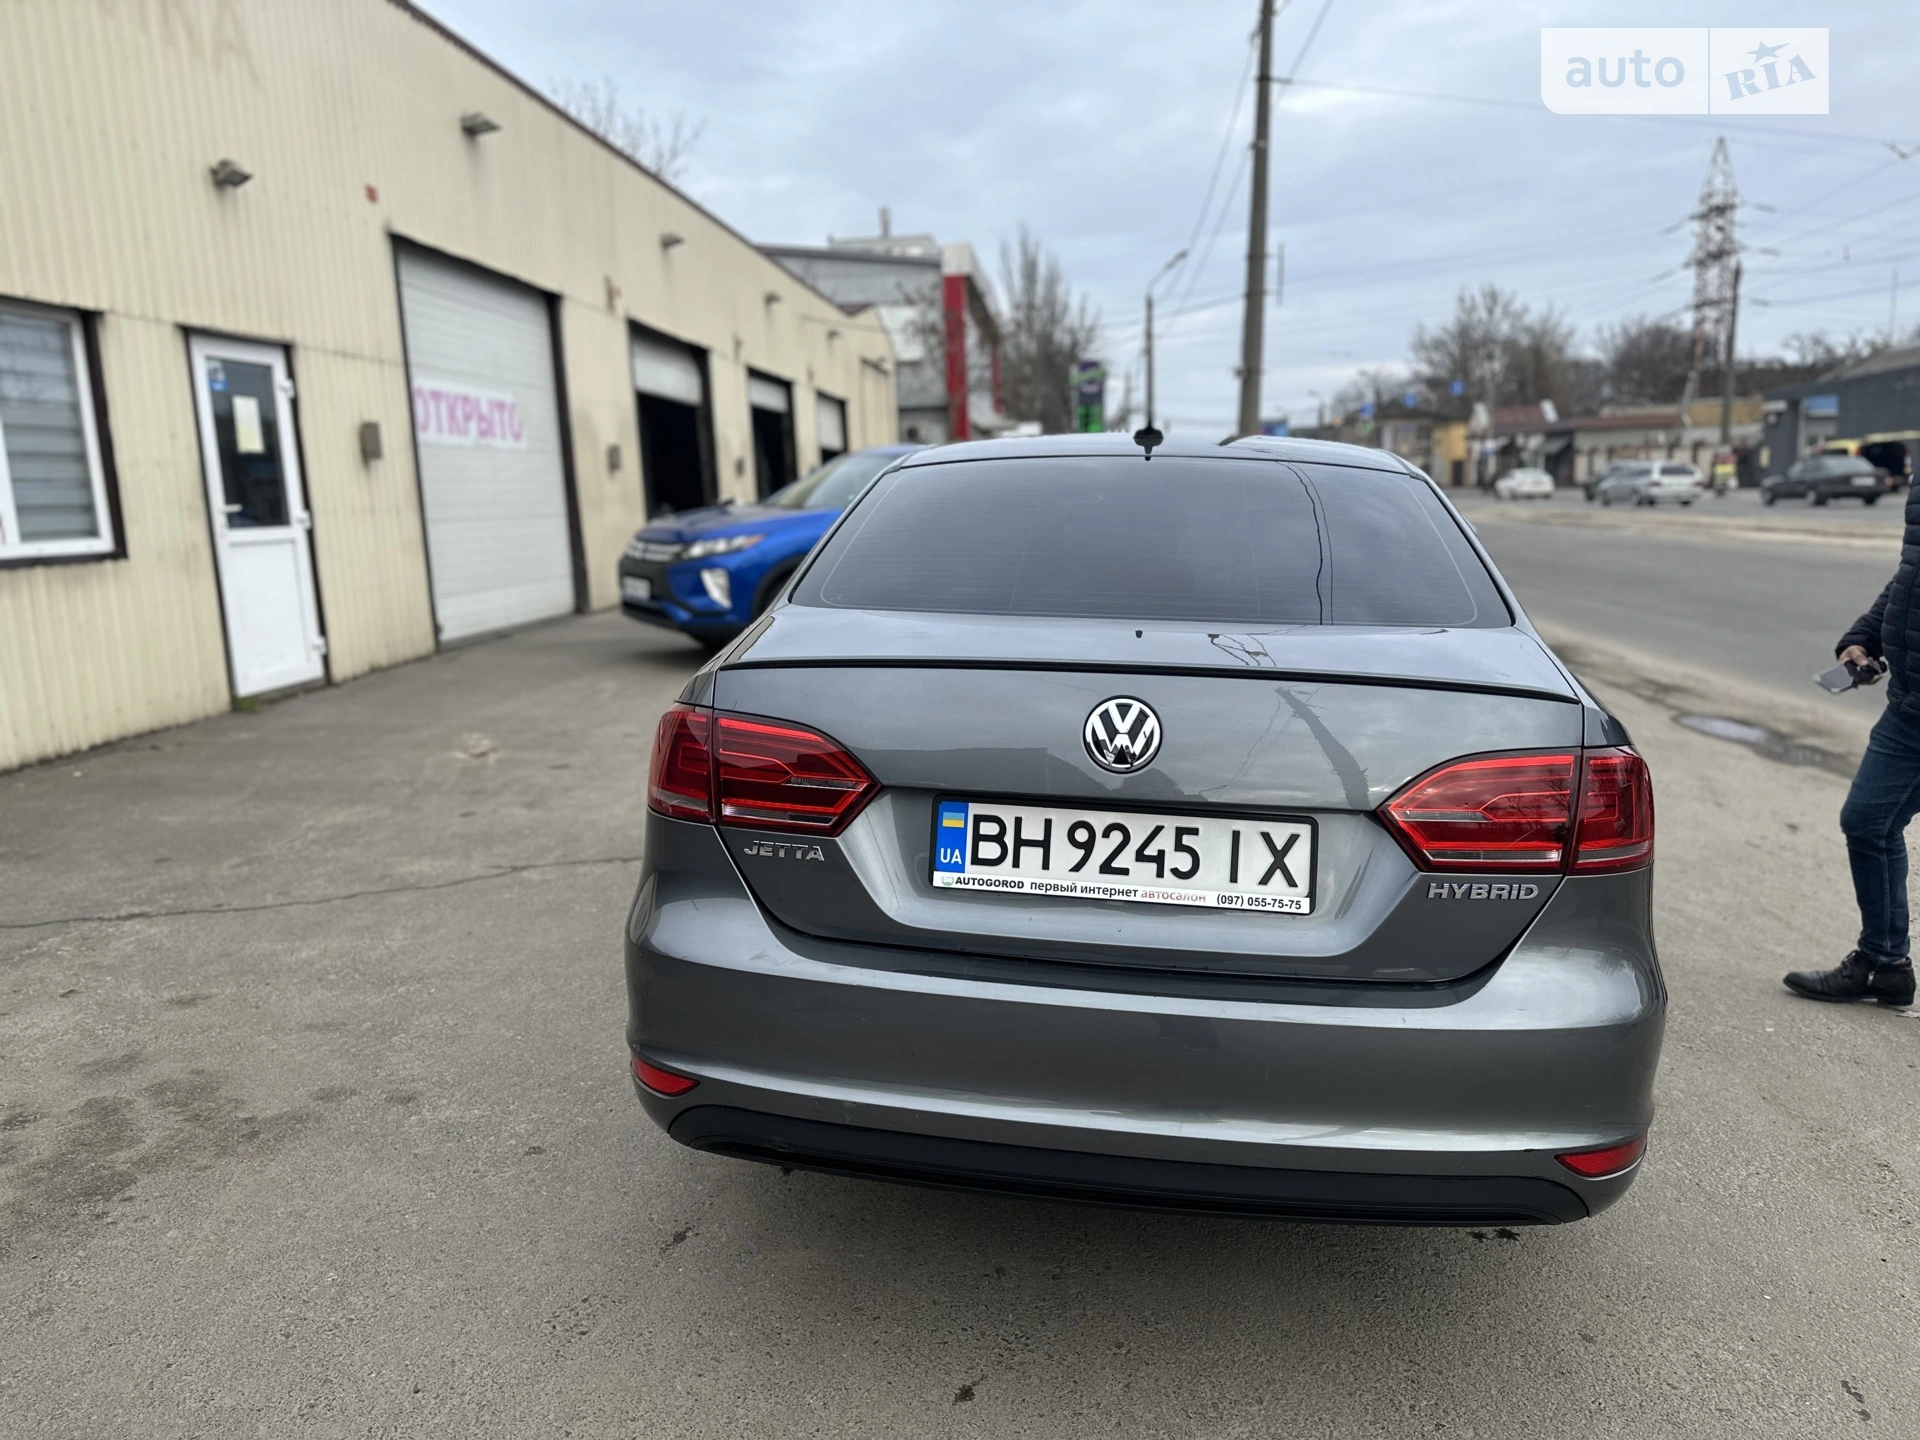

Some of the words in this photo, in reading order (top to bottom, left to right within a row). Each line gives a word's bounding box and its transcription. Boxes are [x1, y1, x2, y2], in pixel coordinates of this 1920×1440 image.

[743, 840, 825, 862] JETTA
[940, 847, 963, 865] UA
[970, 814, 1052, 870] BH
[1067, 820, 1200, 880] 9245
[1229, 830, 1300, 888] IX
[955, 876, 1025, 890] AUTOGOROD
[1030, 881, 1078, 894] первый
[1080, 885, 1139, 899] интернет
[1141, 889, 1206, 903] автосалон
[1427, 882, 1539, 900] HYBRID
[1216, 893, 1244, 907] (097)
[1247, 896, 1302, 911] 055-75-75
